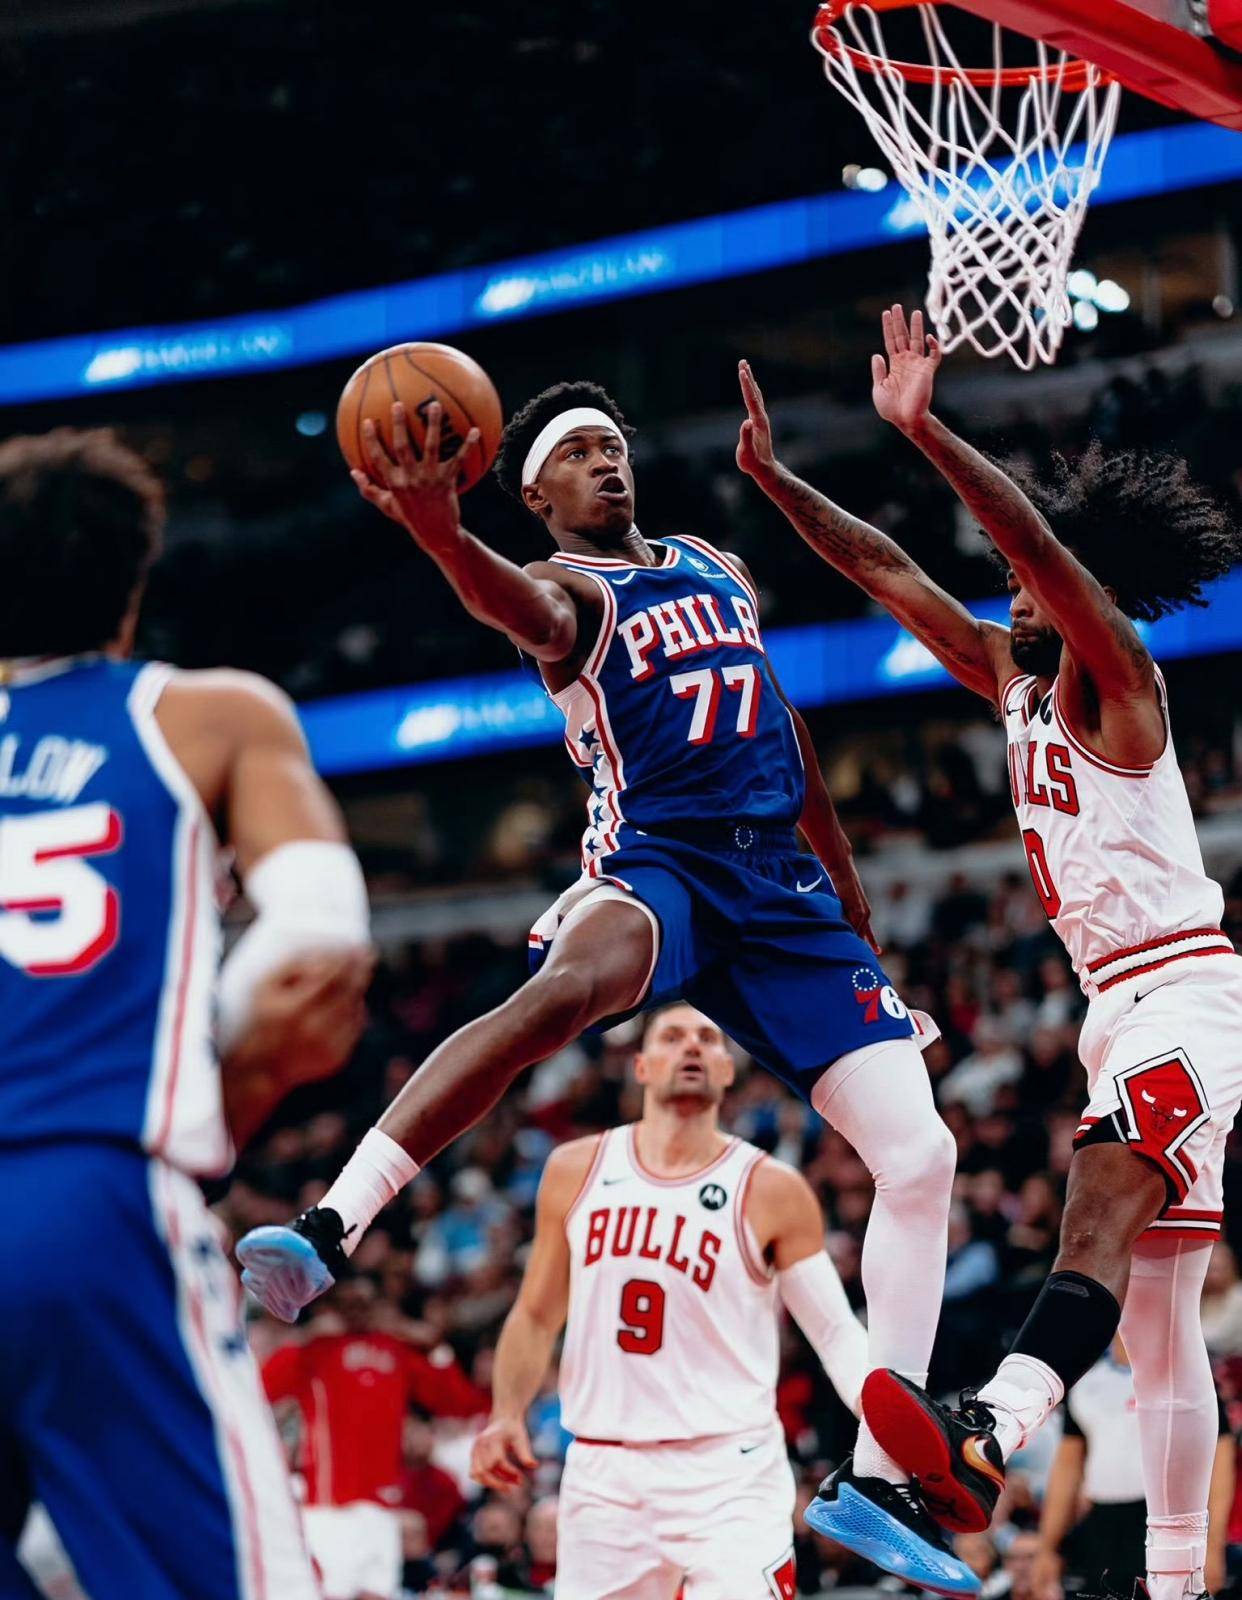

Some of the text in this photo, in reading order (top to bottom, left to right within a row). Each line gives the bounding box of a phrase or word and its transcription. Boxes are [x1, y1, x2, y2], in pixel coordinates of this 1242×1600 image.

[616, 594, 764, 683] PHILA
[669, 664, 762, 745] 77
[0, 801, 124, 977] 5
[854, 985, 908, 1024] 76
[584, 1206, 722, 1293] BULLS
[617, 1278, 666, 1356] 9
